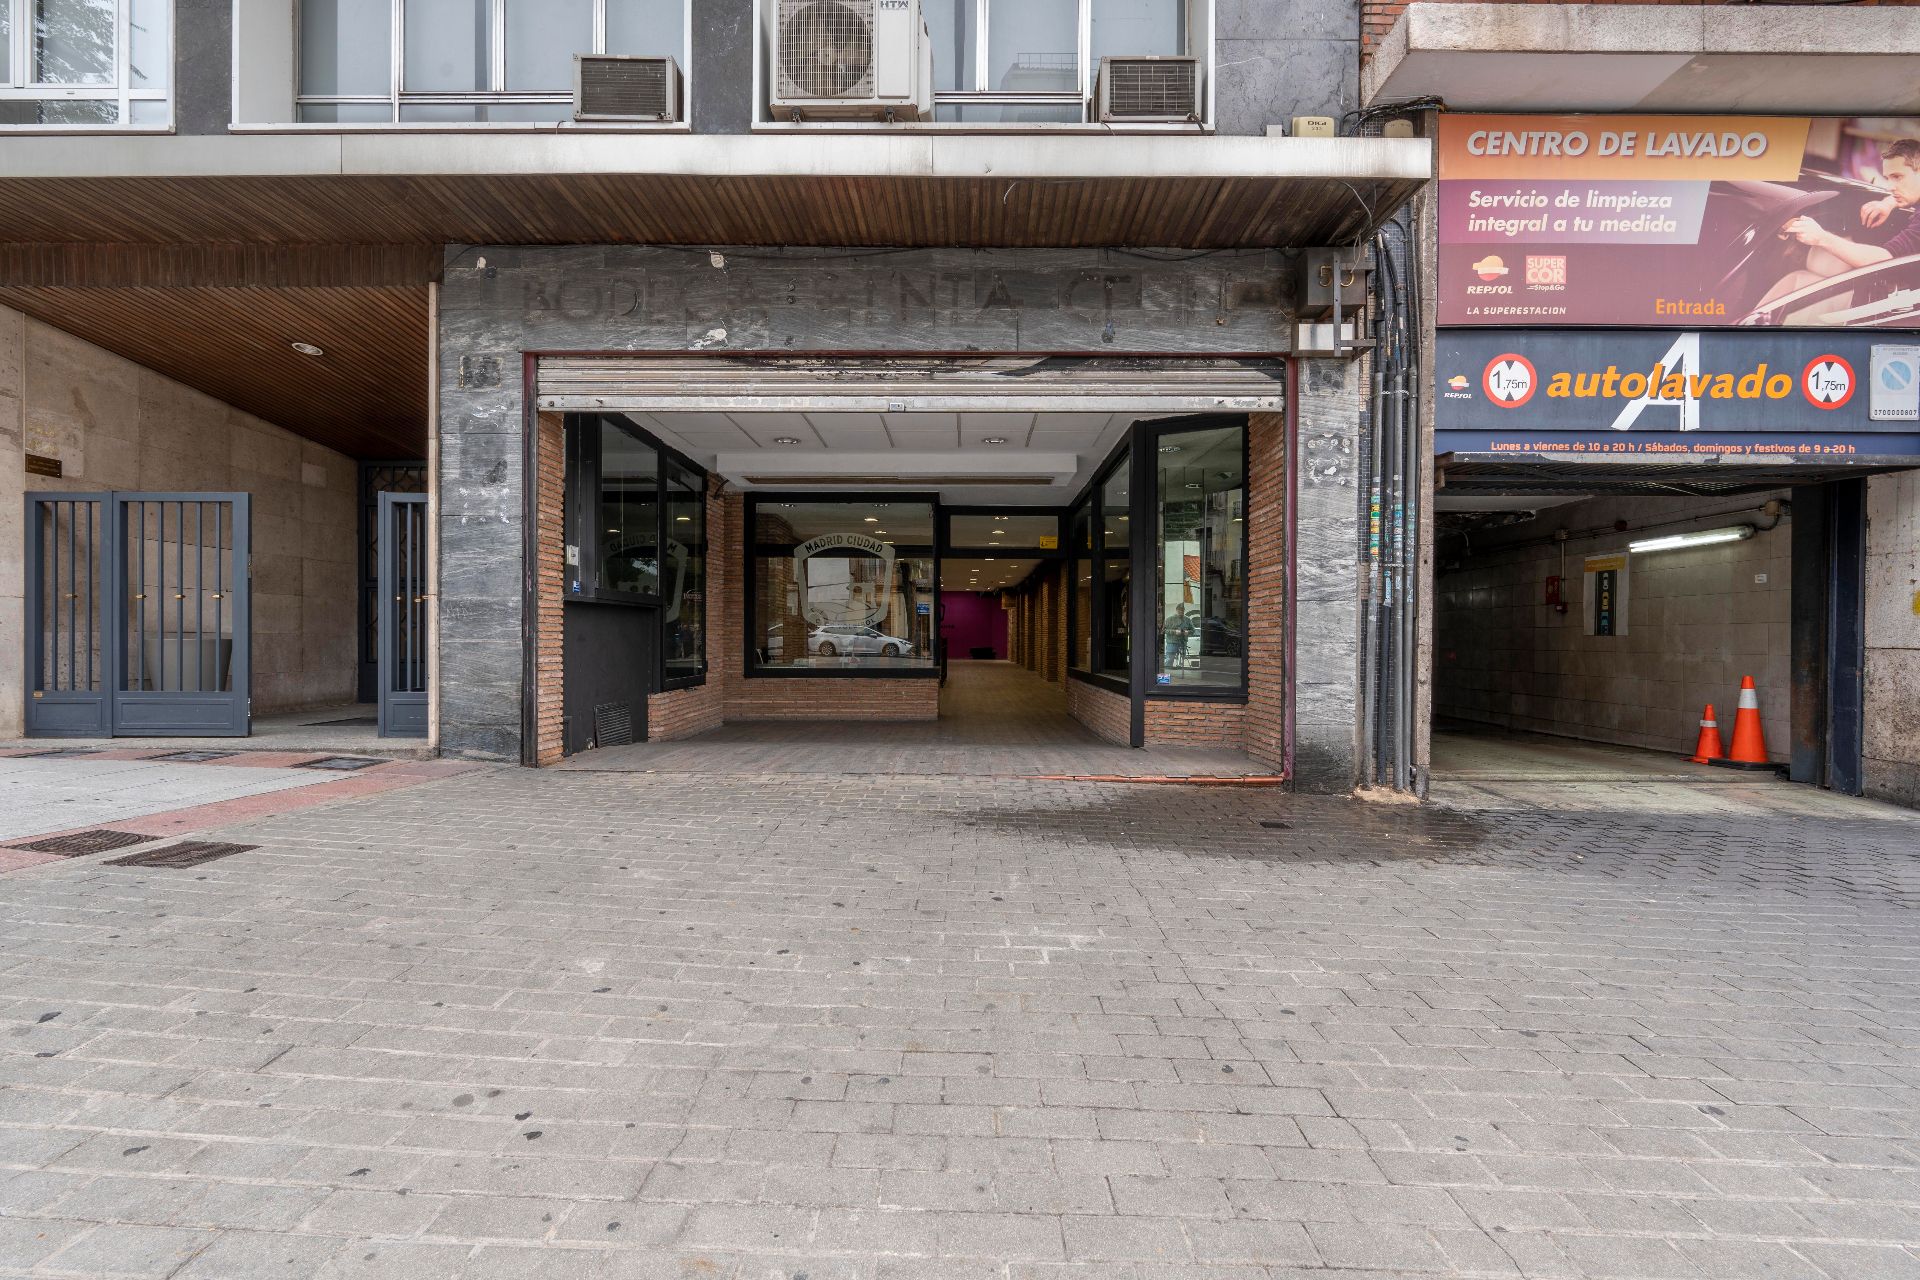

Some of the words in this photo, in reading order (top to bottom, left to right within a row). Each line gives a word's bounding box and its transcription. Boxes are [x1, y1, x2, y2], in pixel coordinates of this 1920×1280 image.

[880, 0, 908, 8] HTW
[1467, 131, 1589, 156] CENTRO
[1598, 131, 1637, 156] DE
[1645, 132, 1768, 157] LAVADO
[1468, 190, 1549, 209] Servicio
[1554, 190, 1581, 208] de
[1586, 190, 1673, 212] limpieza
[1468, 214, 1548, 236] integral
[1553, 219, 1567, 232] a
[1573, 216, 1594, 232] tu
[1599, 214, 1677, 233] medida
[1527, 258, 1565, 268] SUPER
[1527, 269, 1565, 283] COR
[1466, 286, 1513, 294] REPSOL
[1466, 307, 1480, 315] LA
[1483, 307, 1567, 315] SUPERESTACION
[1655, 298, 1726, 315] Entrada
[1492, 370, 1528, 390] 1,75m
[1546, 363, 1794, 400] autolavado
[1811, 371, 1846, 392] 1,75m
[1491, 442, 1521, 451] Lunes
[1533, 442, 1570, 451] viernes
[1573, 442, 1585, 451] de
[1588, 442, 1601, 451] 10
[1612, 442, 1626, 451] 20
[1628, 442, 1635, 451] h
[1645, 442, 1691, 453] Sábados,
[1693, 443, 1742, 454] domingos
[1745, 445, 1752, 454] y
[1754, 443, 1796, 453] festivos
[1798, 444, 1811, 453] de
[1814, 444, 1821, 453] 9
[1832, 444, 1845, 453] 20
[1848, 444, 1855, 453] h
[805, 536, 843, 554] MADRID
[846, 535, 883, 553] CIUDAD
